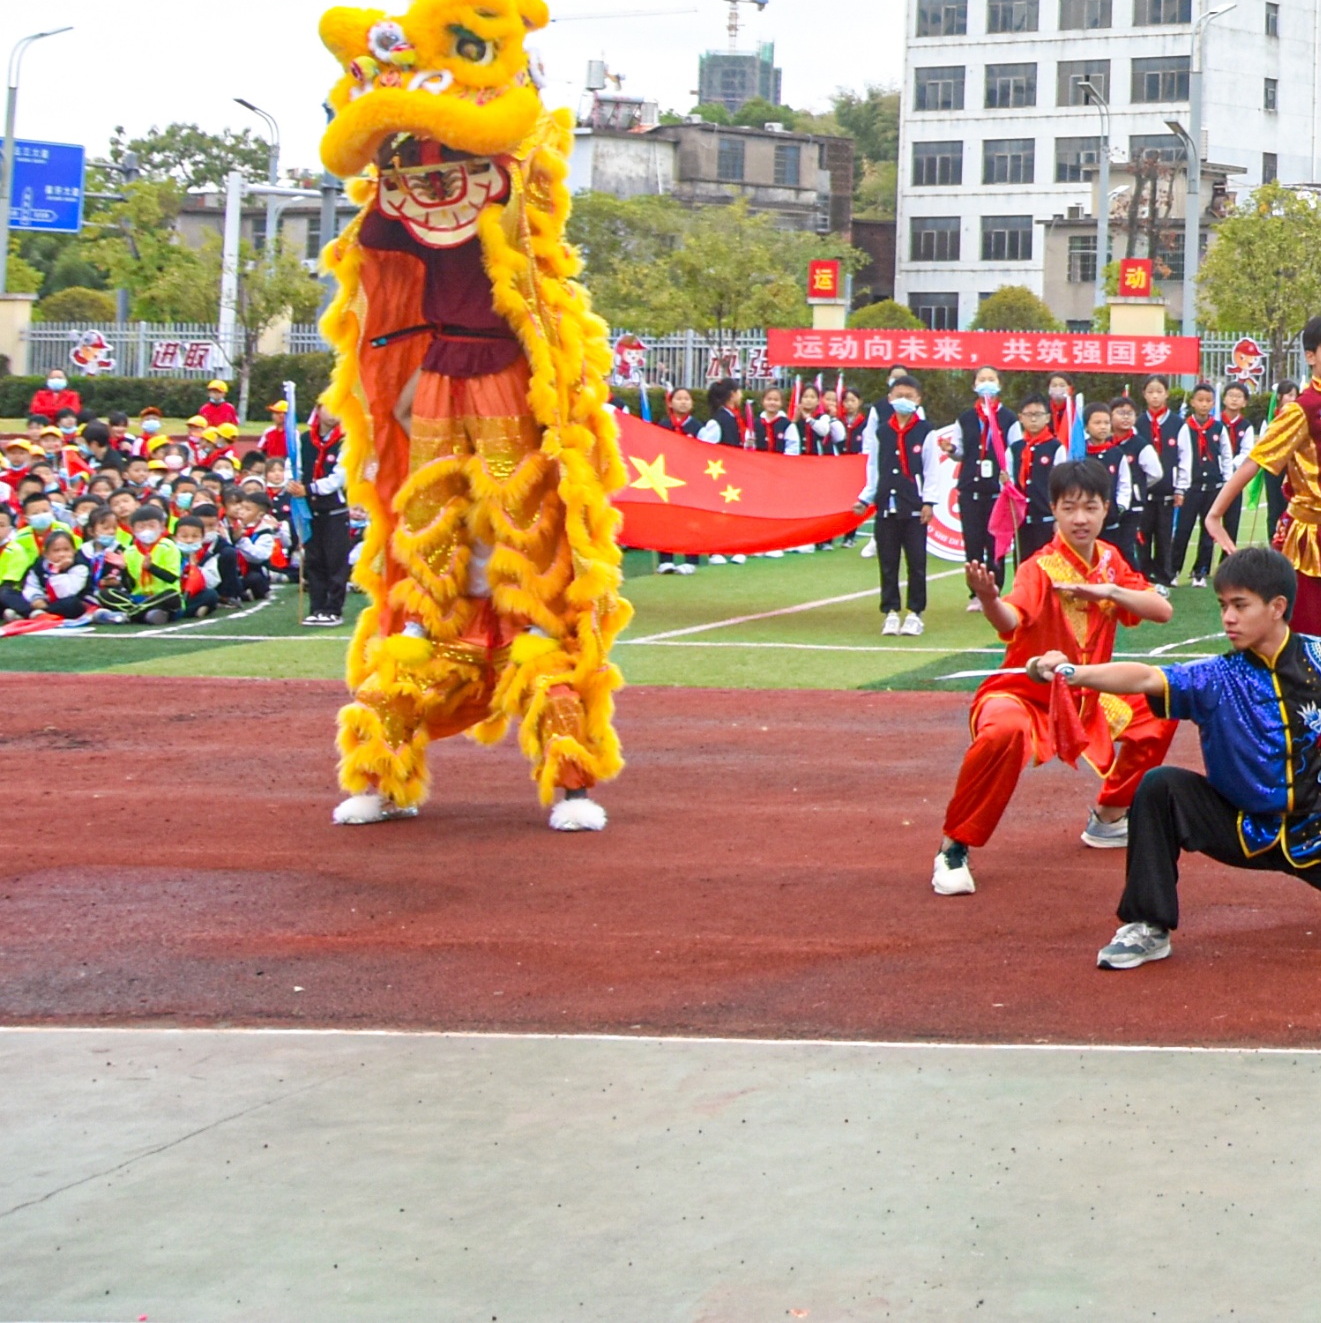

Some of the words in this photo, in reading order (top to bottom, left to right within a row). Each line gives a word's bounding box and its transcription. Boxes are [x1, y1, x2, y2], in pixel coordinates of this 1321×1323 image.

[813, 269, 834, 290] 运
[1124, 266, 1146, 289] 动
[151, 342, 213, 369] 进取
[793, 335, 1172, 367] 运动向未来，共筑强国梦
